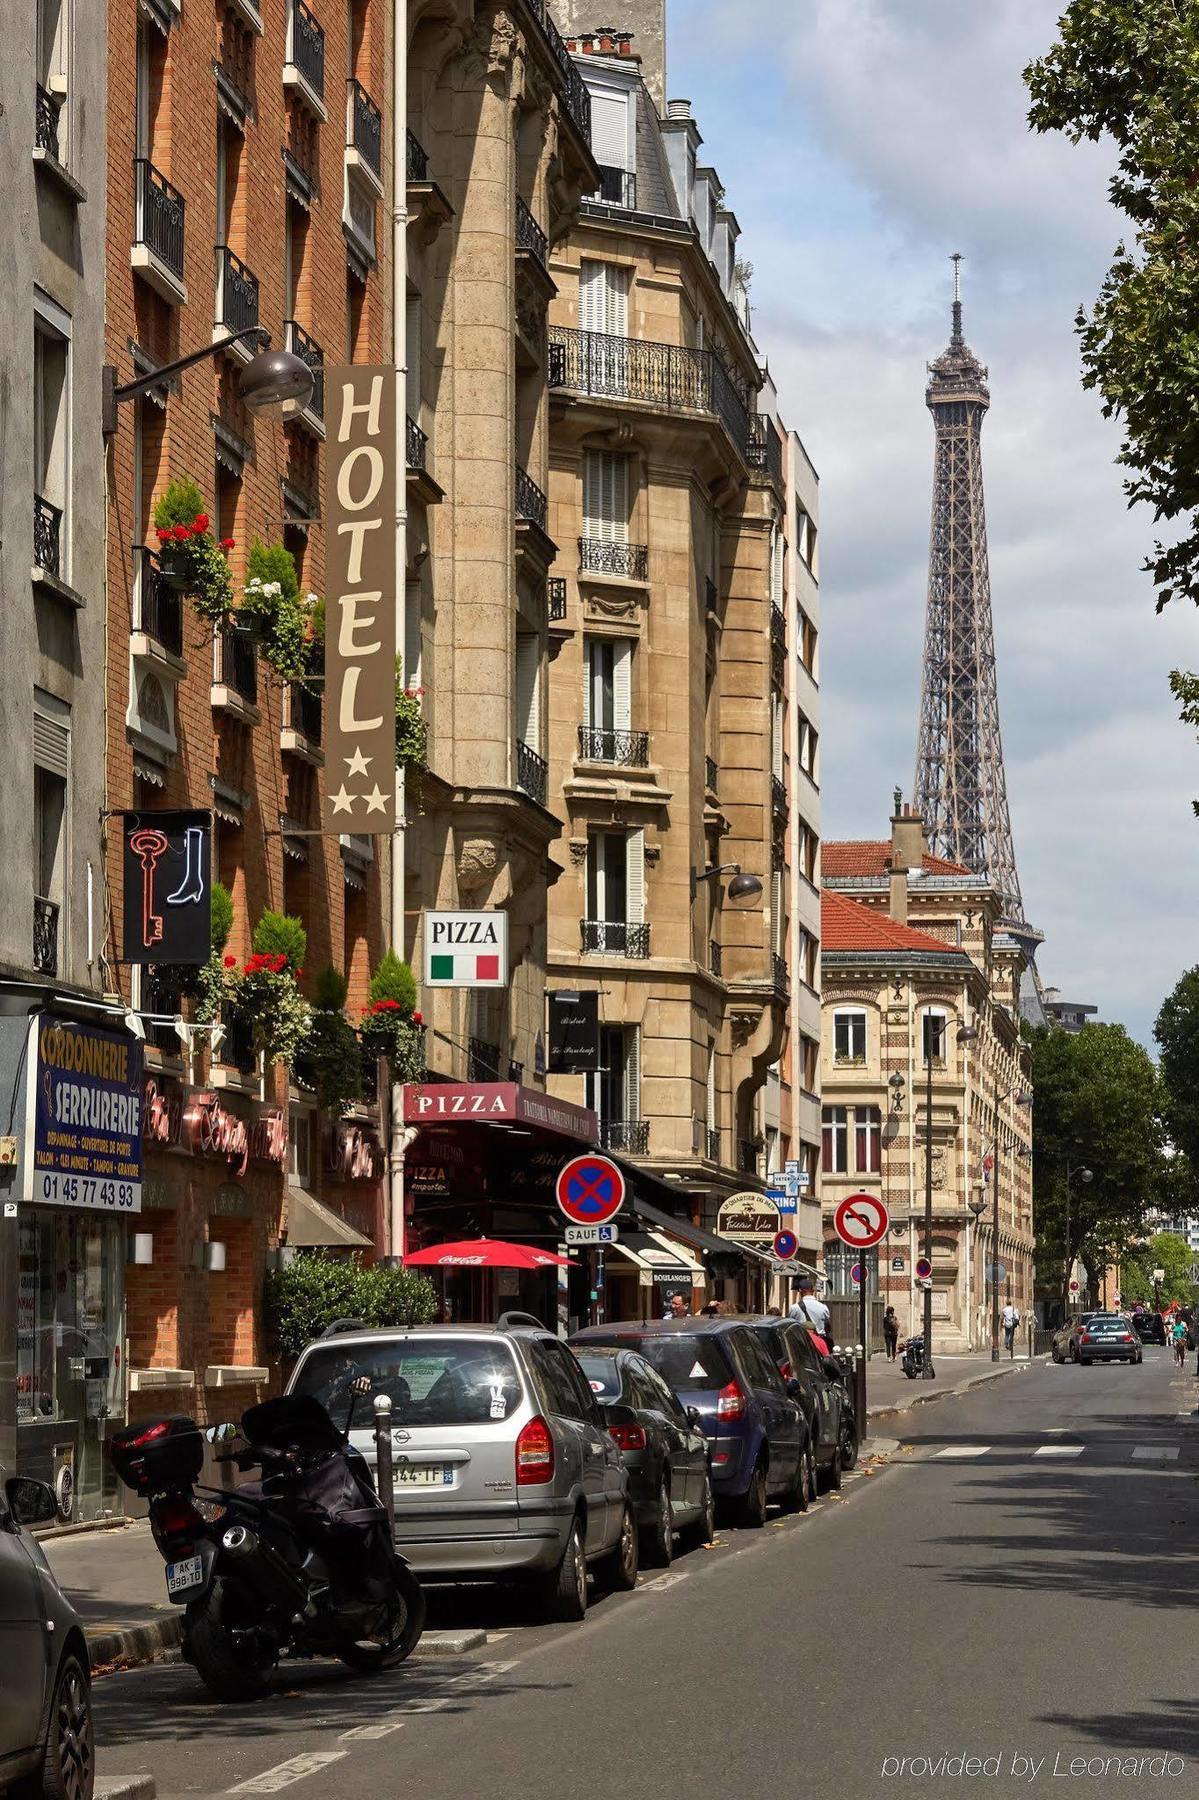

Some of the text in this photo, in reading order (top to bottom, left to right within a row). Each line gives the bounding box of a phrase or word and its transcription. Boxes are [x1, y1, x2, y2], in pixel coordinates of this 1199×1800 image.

[337, 375, 384, 733] HOTEL
[431, 921, 499, 944] PIZZA
[40, 1025, 128, 1084] CORDONNERIE
[55, 1081, 140, 1137] SERRURERIE
[417, 1095, 508, 1114] PIZZA
[36, 1151, 54, 1166] TALON
[70, 1155, 89, 1171] MINUTE
[93, 1158, 113, 1173] TAMPON
[117, 1163, 139, 1177] GRAVURE
[406, 1167, 446, 1181] PIZZA
[43, 1175, 58, 1199] 01
[63, 1178, 78, 1201] 45
[82, 1180, 97, 1203] 77
[100, 1182, 115, 1206] 43
[119, 1184, 133, 1208] 93
[770, 1196, 796, 1208] KING
[723, 1203, 729, 1211] LE
[567, 1229, 597, 1240] SAUF
[653, 1274, 691, 1282] BOULANGER
